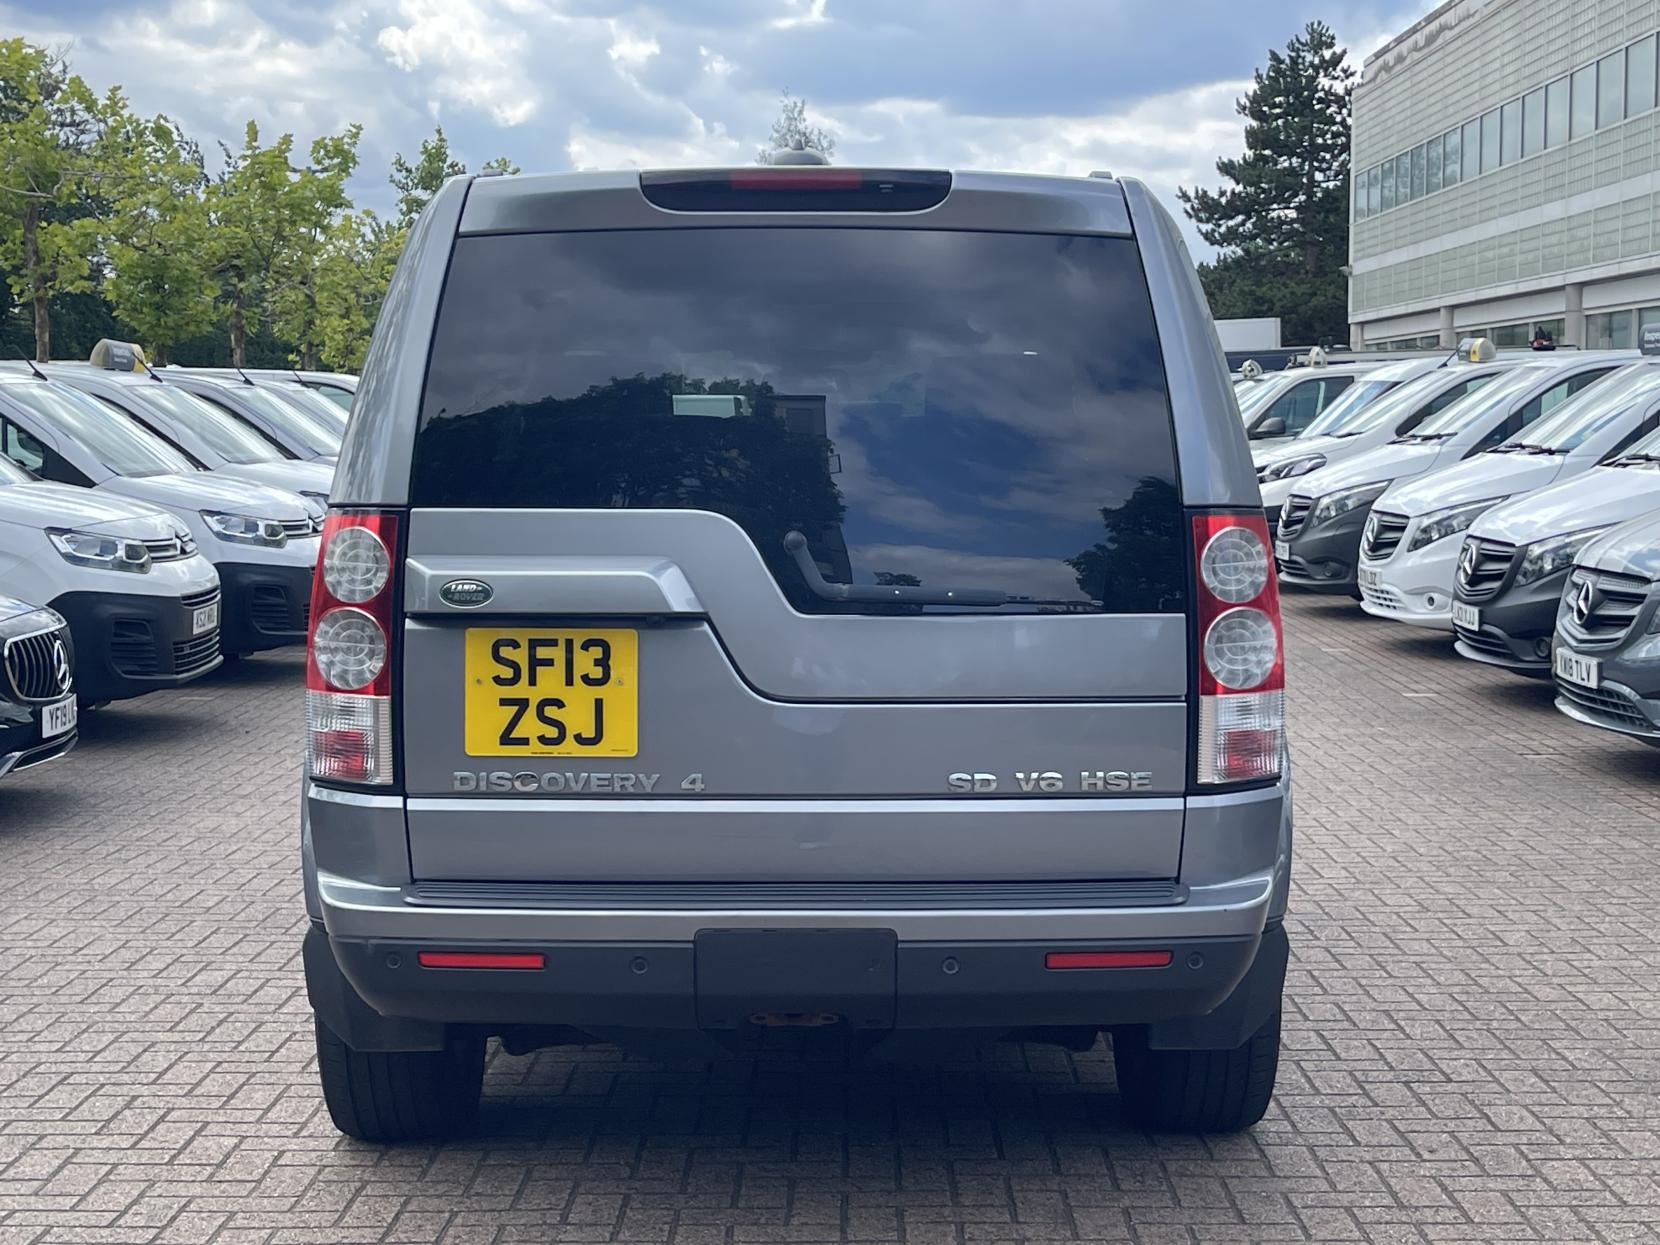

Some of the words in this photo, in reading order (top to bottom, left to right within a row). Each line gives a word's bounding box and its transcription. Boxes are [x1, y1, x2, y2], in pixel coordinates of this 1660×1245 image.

[450, 584, 477, 592] LAND
[452, 593, 485, 601] ROVER
[491, 638, 612, 687] SF13
[49, 702, 67, 731] YF19
[498, 697, 605, 746] ZSJ
[452, 770, 660, 793] DISCOVERY
[680, 772, 706, 792] 4
[947, 771, 998, 793] SD
[1015, 771, 1063, 792] V6
[1081, 771, 1153, 791] HSE
